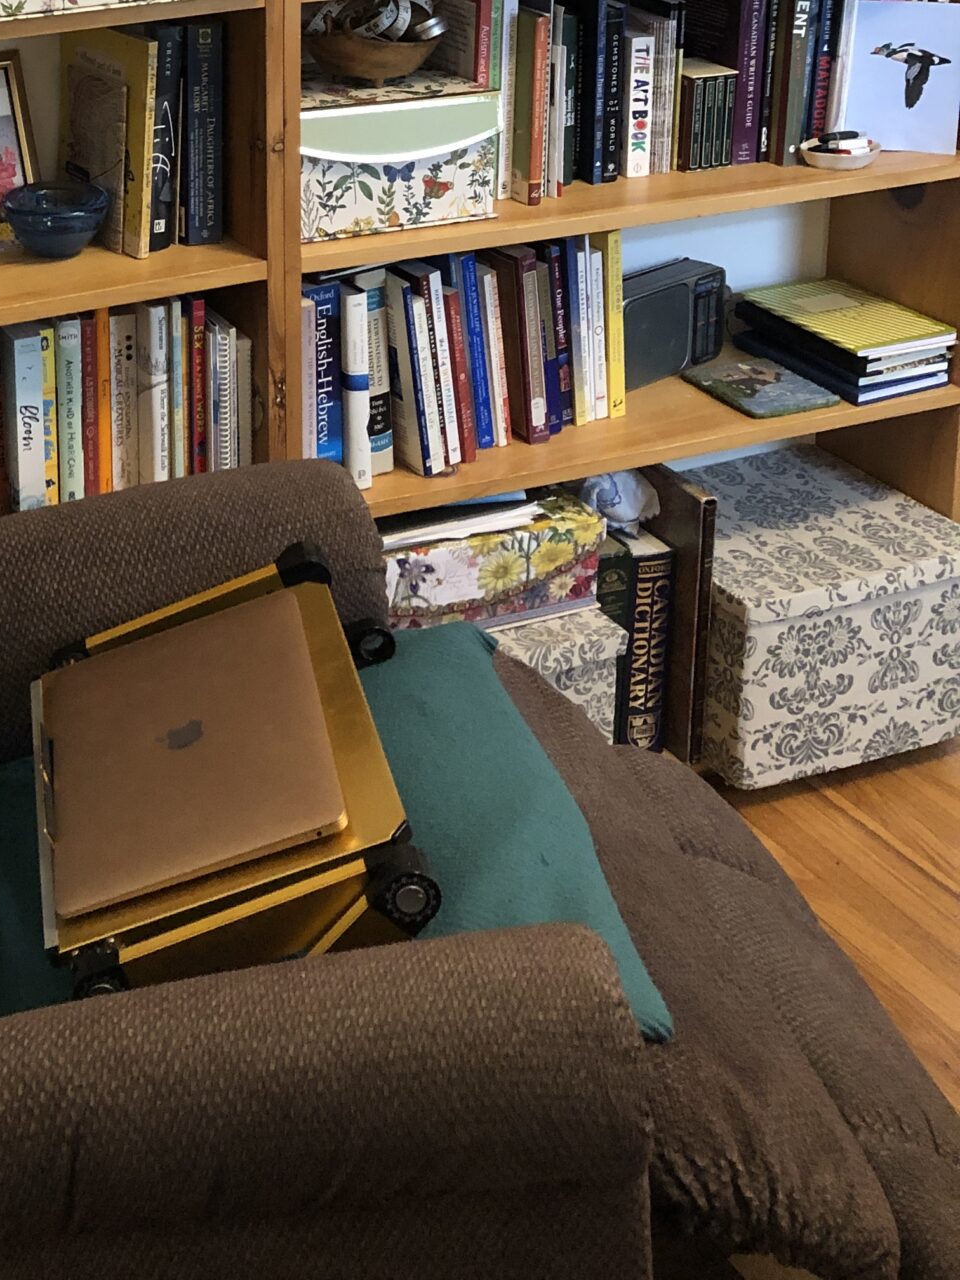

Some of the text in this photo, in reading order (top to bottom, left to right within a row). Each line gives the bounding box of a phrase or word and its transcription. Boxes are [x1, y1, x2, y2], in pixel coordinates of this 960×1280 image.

[479, 25, 489, 71] Autism and
[749, 12, 758, 58] CANADIAN
[610, 34, 619, 94] GEMSTONES
[634, 45, 649, 74] THE
[747, 59, 755, 101] WRITER'S
[745, 103, 754, 129] GUIDE
[206, 118, 216, 227] DAUGHTERS OF AFRICA
[194, 326, 204, 349] SEX
[315, 303, 332, 447] English-Hebrew
[20, 405, 39, 452] Bloom
[628, 582, 653, 711] DICTIONARY
[646, 579, 670, 709] CANADIAN
